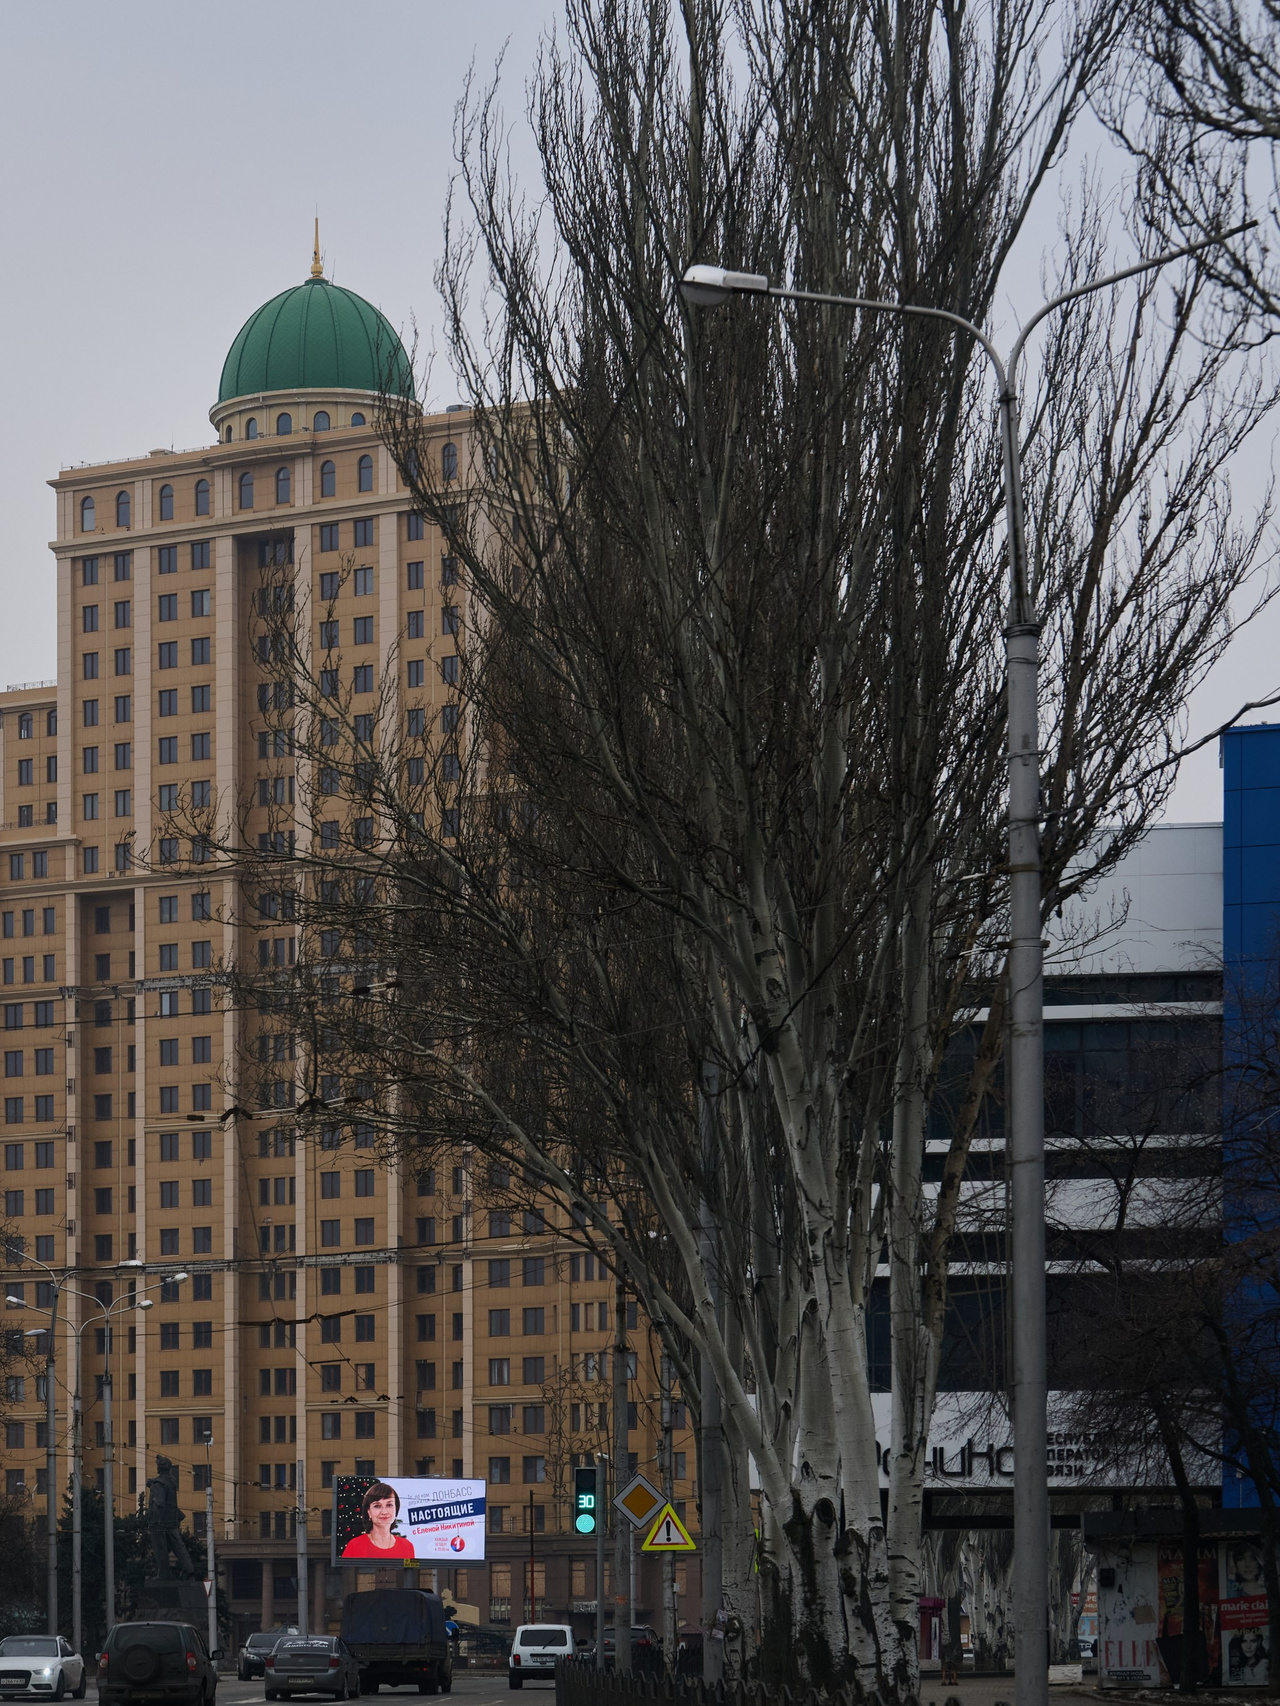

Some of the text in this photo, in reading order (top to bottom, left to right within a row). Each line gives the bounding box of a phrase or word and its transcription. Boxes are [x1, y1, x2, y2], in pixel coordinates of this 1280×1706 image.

[432, 1486, 473, 1501] ДОНБАСС
[578, 1494, 595, 1508] 30
[410, 1502, 475, 1523] НАСТОЯЩИЕ
[417, 1525, 440, 1535] Еленой
[440, 1519, 475, 1531] Никитиной
[1158, 1547, 1217, 1560] MAIM
[1221, 1599, 1269, 1611] marie clai
[1104, 1640, 1156, 1667] ELLE
